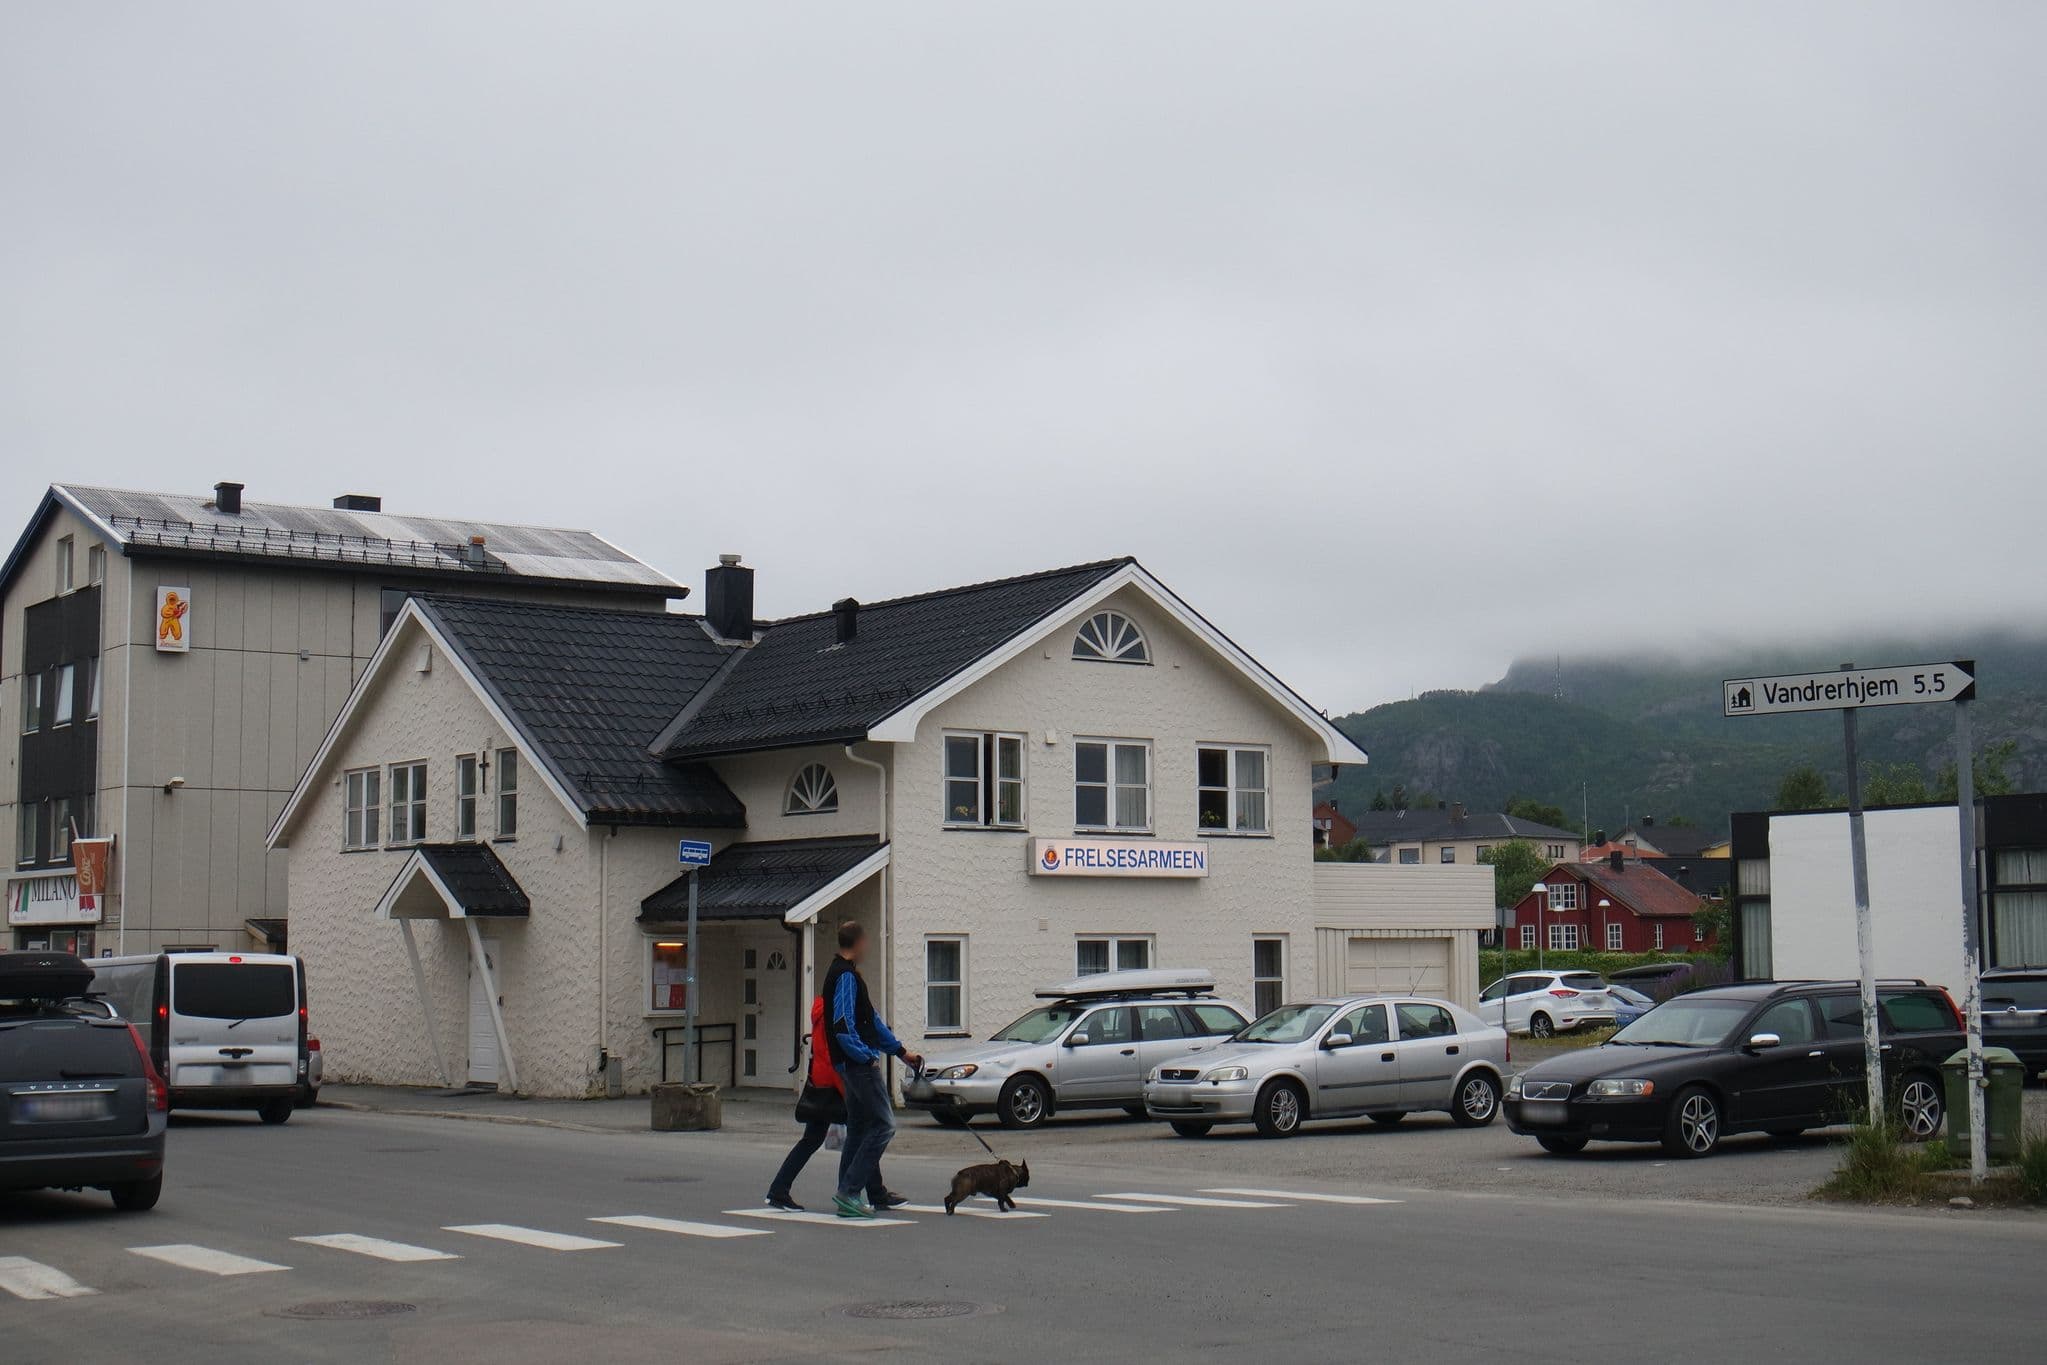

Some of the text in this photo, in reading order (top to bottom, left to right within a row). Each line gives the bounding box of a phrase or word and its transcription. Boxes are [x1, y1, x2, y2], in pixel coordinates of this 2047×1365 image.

[1763, 673, 1945, 704] Vandrerhjem 5,5
[1065, 848, 1204, 869] FRELSESARMEEN
[31, 876, 77, 902] MILANO
